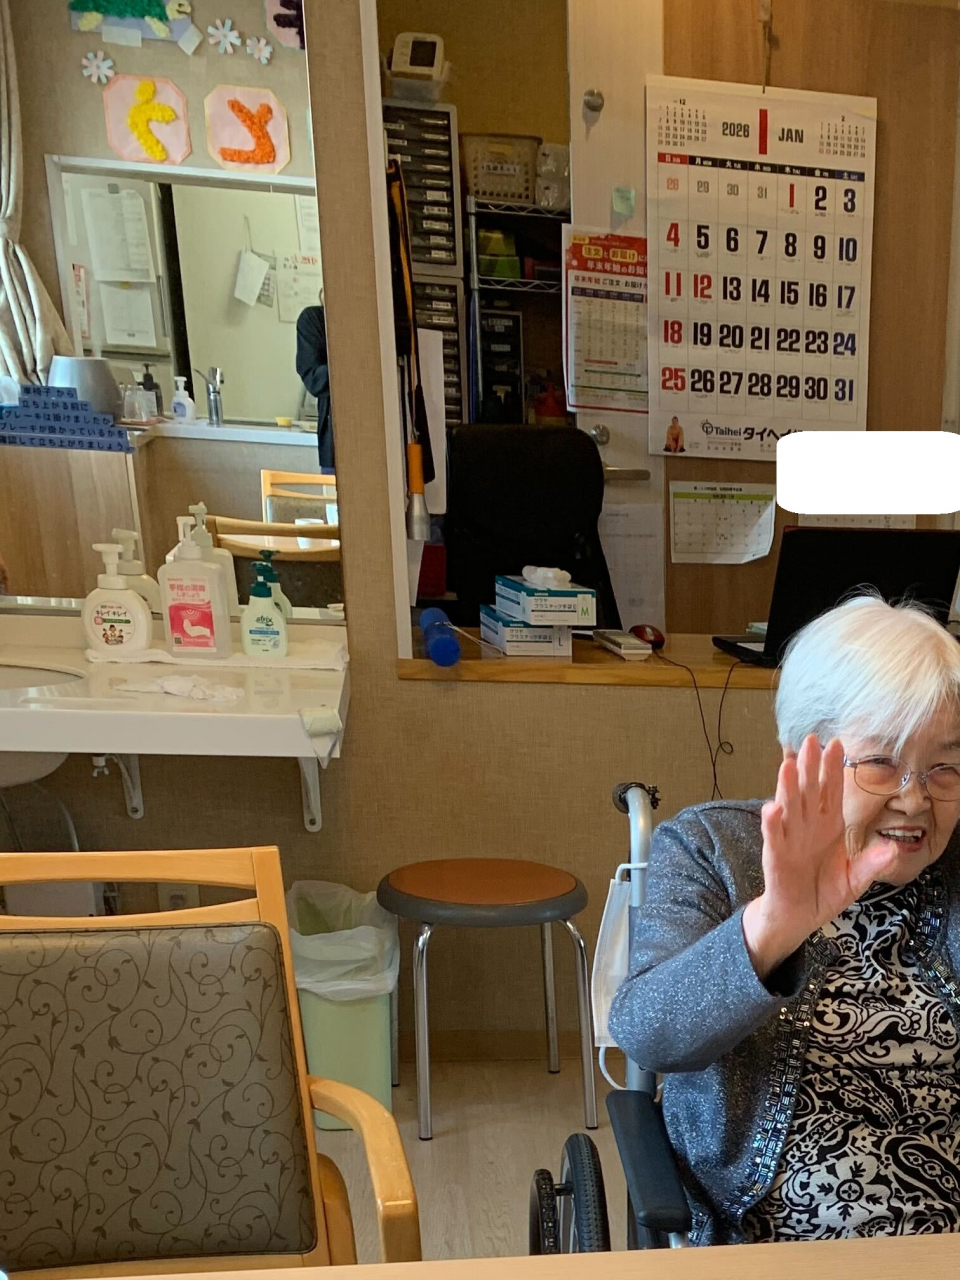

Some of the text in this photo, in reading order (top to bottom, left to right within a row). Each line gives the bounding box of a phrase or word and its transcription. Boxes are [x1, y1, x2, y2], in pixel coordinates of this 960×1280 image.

[722, 121, 750, 138] 2026
[759, 108, 768, 155] 1
[778, 127, 804, 144] JAN
[695, 157, 701, 165] 月
[725, 160, 732, 168] 火
[842, 172, 849, 180] 土
[667, 178, 855, 212] 28 29 30 31 1 2 3
[667, 223, 857, 262] 4 5 6 7 8 9 10
[587, 260, 647, 275] 年末年始のお知
[665, 272, 681, 296] 11
[694, 274, 712, 299] 12
[723, 276, 741, 301] 13
[752, 278, 770, 303] 14
[781, 281, 799, 305] 15
[809, 283, 827, 307] 16
[838, 286, 855, 309] 17
[664, 320, 856, 356] 18 19 20 21 22 23 24
[662, 367, 853, 401] 25 26 27 28 29 30 31
[22, 400, 90, 412] 立ち上がる前に
[714, 426, 741, 437] Taihei
[580, 606, 590, 616] M
[558, 636, 563, 647] L
